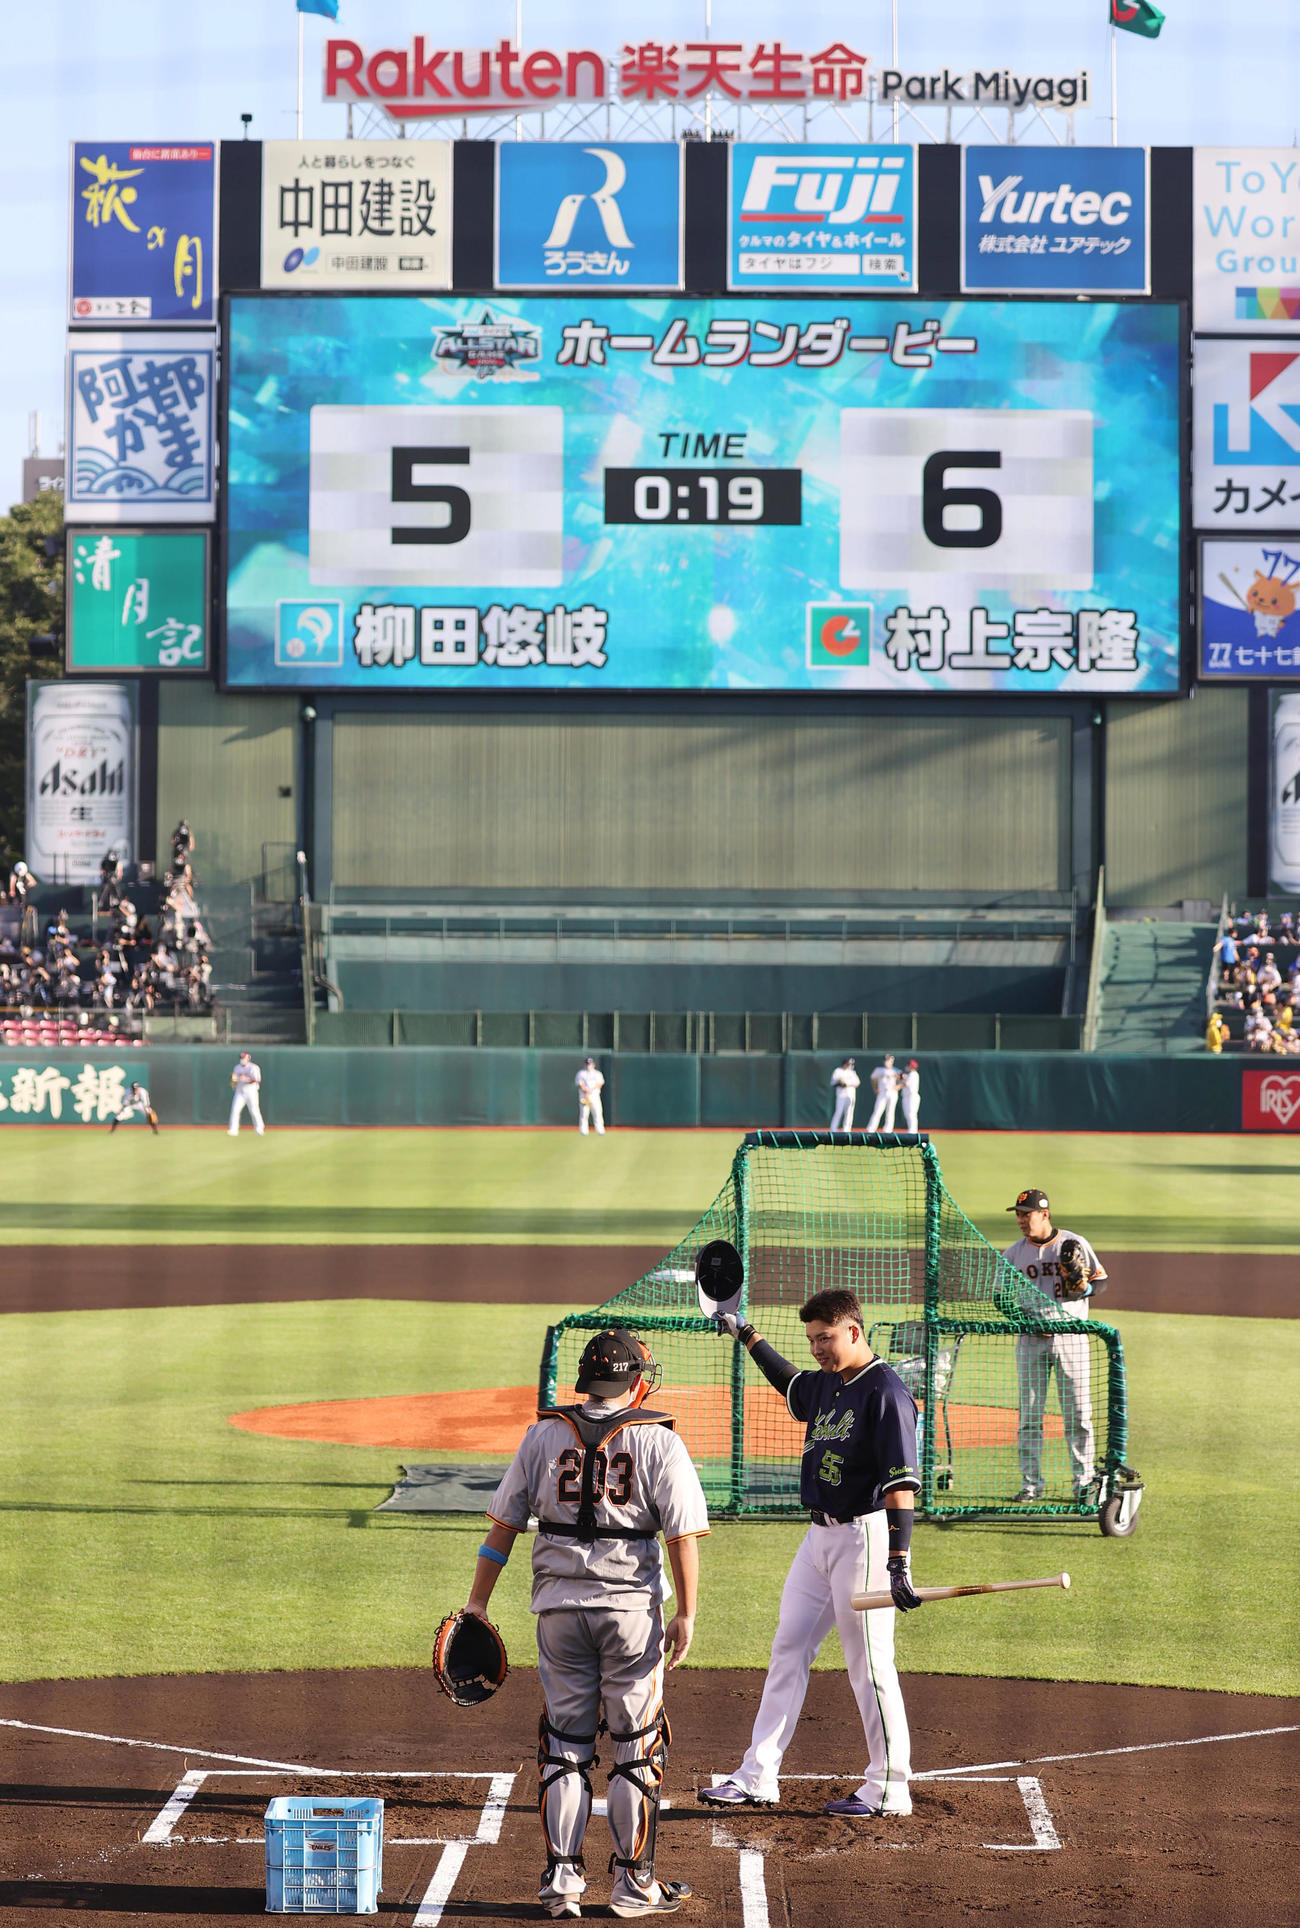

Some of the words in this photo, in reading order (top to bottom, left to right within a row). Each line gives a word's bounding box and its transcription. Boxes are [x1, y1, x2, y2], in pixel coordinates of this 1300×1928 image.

[326, 36, 605, 98] Rakuten
[621, 42, 868, 100] 楽天生命
[882, 70, 964, 100] Park
[974, 71, 1087, 106] Miyagi
[299, 155, 416, 168] 人と暮らしをつなぐ
[1216, 161, 1300, 194] ToY
[280, 177, 436, 237] 中田建設
[741, 156, 905, 224] Fuji
[978, 175, 1132, 225] Yurtec
[543, 251, 630, 276] ろうきん
[745, 256, 833, 270] タイヤはフジ
[979, 234, 1048, 254] 株式会社
[1049, 237, 1132, 255] ユアテック
[557, 319, 977, 367] ホームランダービー
[659, 433, 747, 458] TIME
[391, 446, 471, 545] 5
[634, 476, 764, 520] 0:19
[923, 451, 1002, 548] 6
[353, 604, 608, 668] 柳田悠岐
[886, 608, 1139, 672] 村上宗隆
[40, 760, 124, 796] Asahi
[0, 1063, 134, 1122] 新報
[613, 1362, 629, 1372] 217
